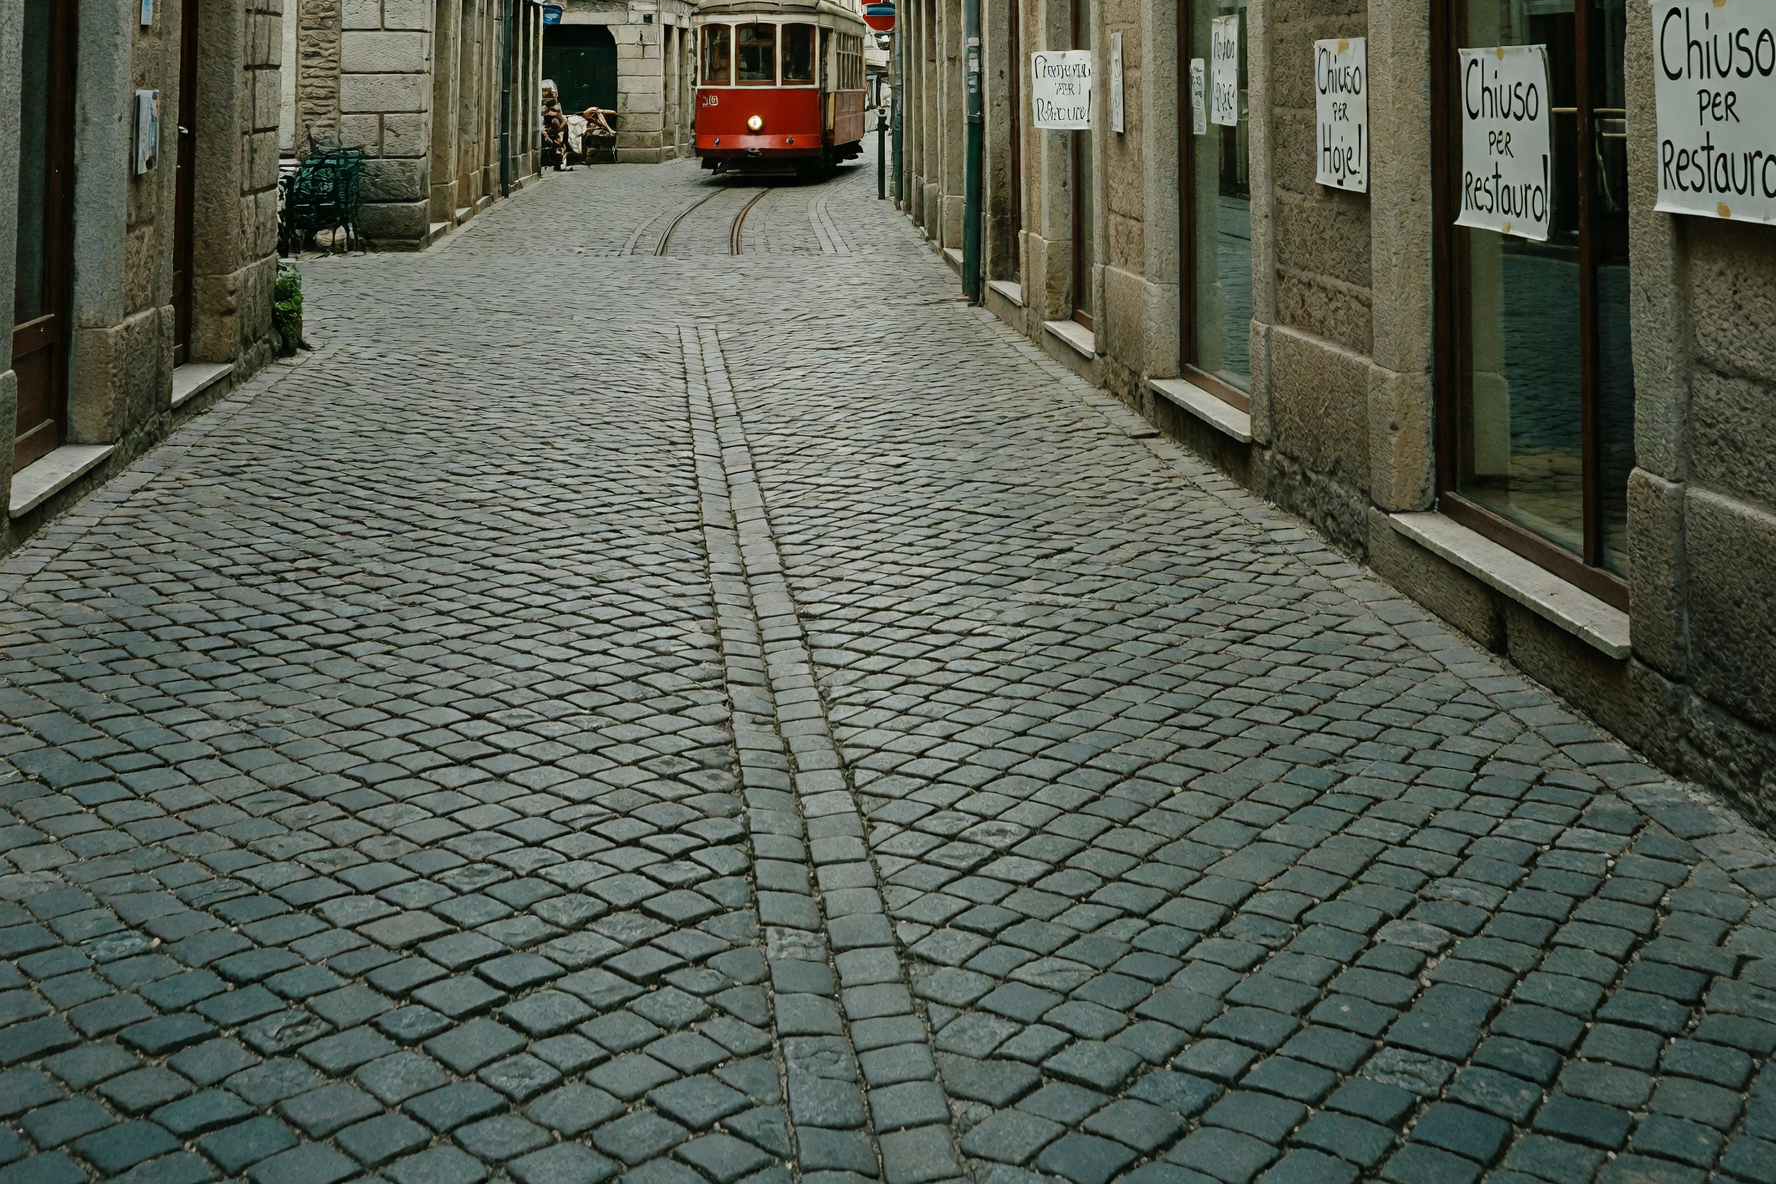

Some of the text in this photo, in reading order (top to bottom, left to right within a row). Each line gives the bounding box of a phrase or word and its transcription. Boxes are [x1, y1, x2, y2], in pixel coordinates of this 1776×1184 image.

[1318, 47, 1362, 95] Chiuso
[1661, 7, 1776, 81] Chiuso
[1465, 58, 1539, 121] Chiuso
[1322, 122, 1363, 185] Hoje!
[1465, 153, 1548, 224] Restauro!
